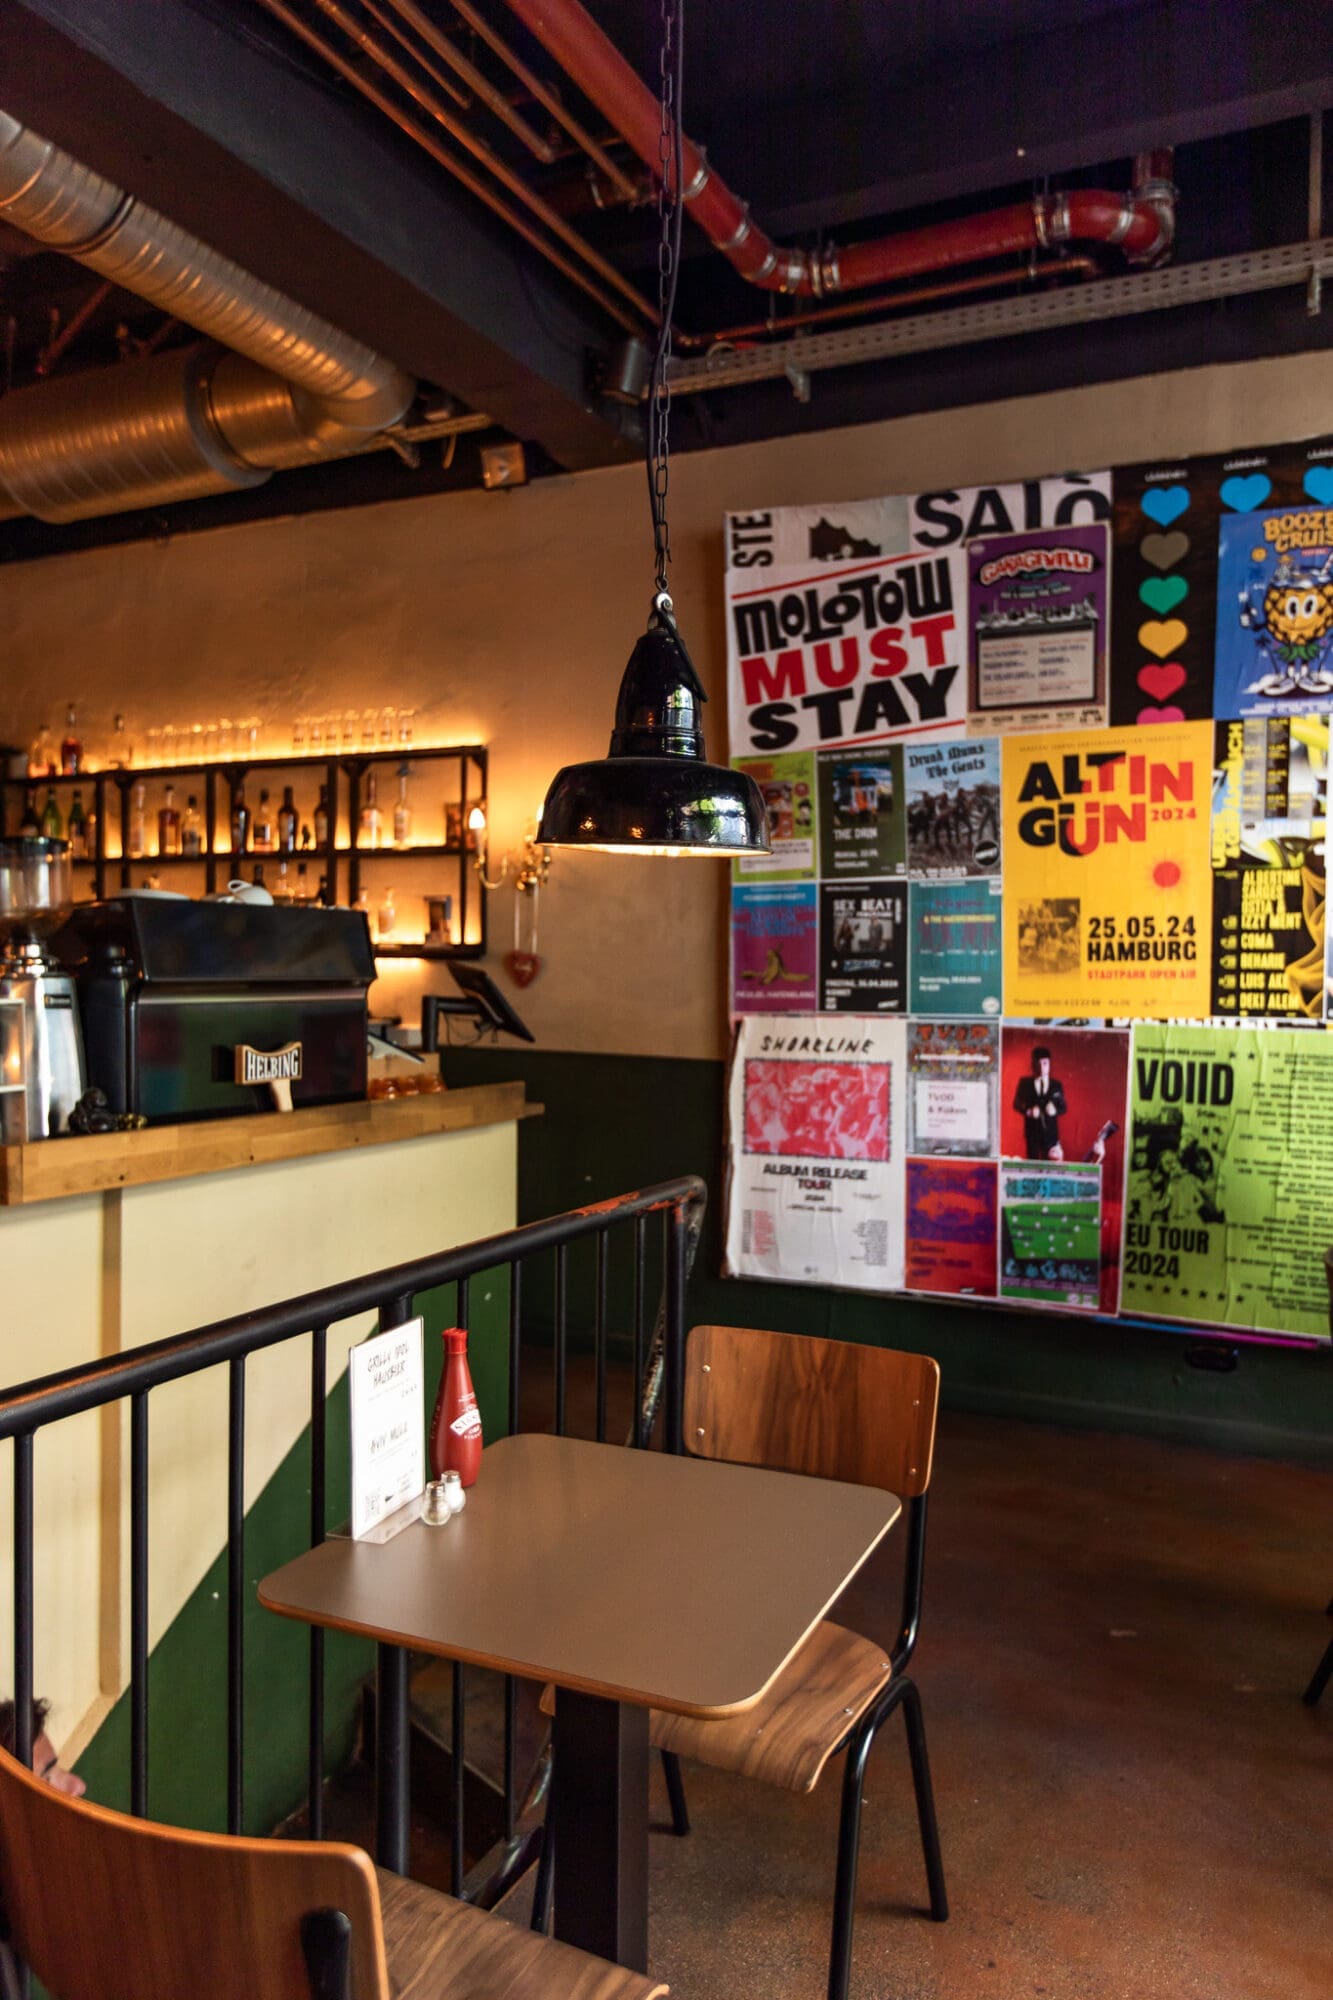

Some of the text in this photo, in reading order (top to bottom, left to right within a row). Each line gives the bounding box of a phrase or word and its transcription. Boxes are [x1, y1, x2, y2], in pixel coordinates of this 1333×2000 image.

[733, 558, 954, 656] MOLOTOW
[739, 615, 956, 706] MUST
[749, 665, 959, 751] STAY
[1017, 751, 1194, 803] ALTIN
[1151, 807, 1197, 821] 2024
[1018, 802, 1146, 857] GÜN
[1088, 915, 1196, 938] 25.05.24
[1241, 932, 1275, 950] COMA
[1087, 940, 1197, 962] HAMBURG
[1150, 969, 1177, 979] OPEN
[761, 1035, 875, 1054] SHORELINE
[246, 1048, 299, 1081] HELBING
[1137, 1059, 1234, 1106] VOIID
[763, 1164, 868, 1181] ALBUM RELEASE
[798, 1178, 832, 1191] TOUR
[1126, 1223, 1210, 1255] EU TOUR
[1125, 1250, 1179, 1279] 2024
